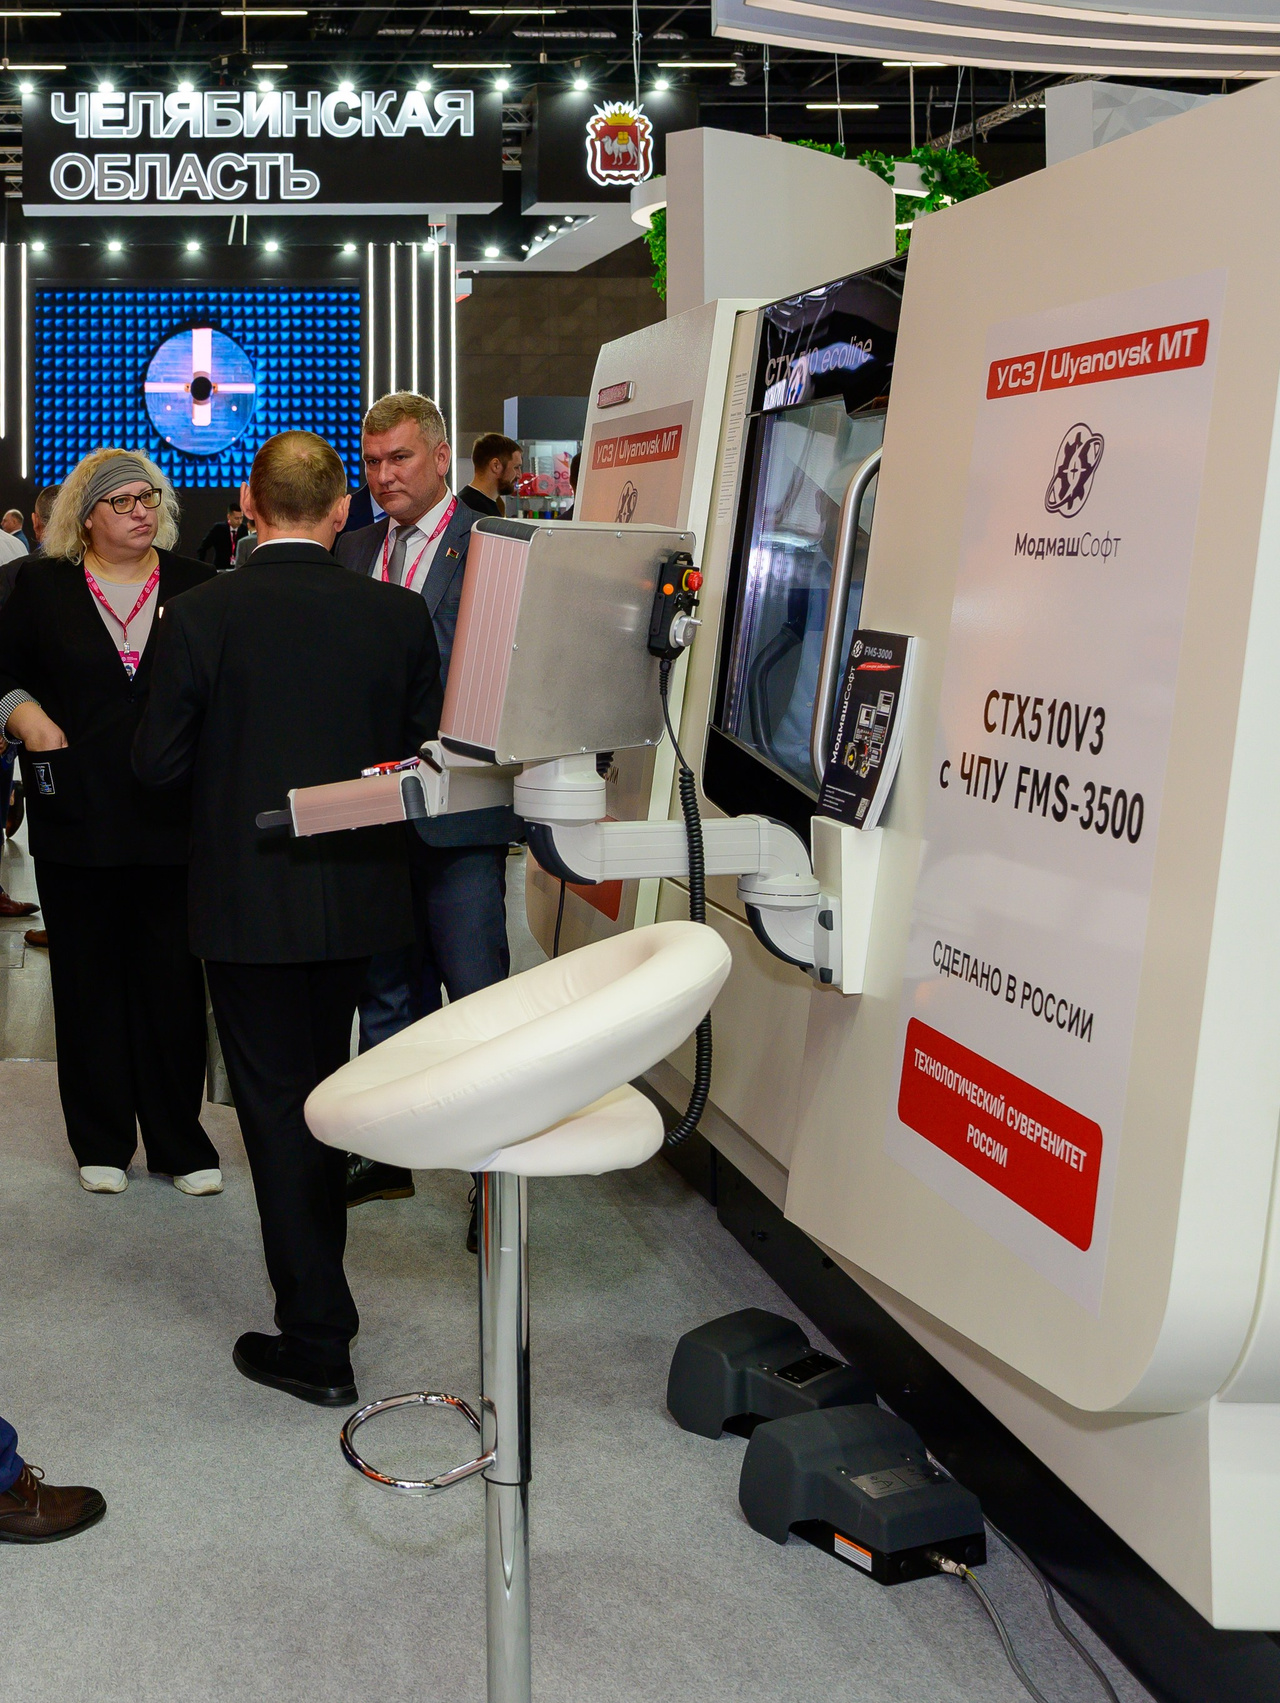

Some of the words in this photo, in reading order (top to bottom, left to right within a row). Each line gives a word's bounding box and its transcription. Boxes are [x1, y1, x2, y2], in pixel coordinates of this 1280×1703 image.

[50, 90, 475, 139] ЧЕЛЯБИНСКАЯ
[50, 153, 320, 200] ОБЛАСТЬ
[765, 353, 795, 386] CTX
[822, 336, 873, 373] ecoline
[1051, 338, 1153, 383] Ulyanovsk
[1158, 327, 1198, 362] MT
[619, 433, 660, 464] Ulyanovsk
[662, 430, 678, 453] MT
[1014, 530, 1121, 563] МодмашСофт
[864, 646, 893, 660] FMS-3000
[831, 666, 856, 764] МодмашСофт
[983, 690, 1106, 755] CTX510V3
[939, 760, 951, 788] с
[960, 752, 1008, 803] ЧПУ
[1014, 765, 1144, 844] FMS-3500
[933, 940, 1002, 996] СДЕЛАНО
[1005, 974, 1017, 1003] В
[1020, 981, 1094, 1043] РОССИИ
[914, 1048, 1005, 1122] ТЕХНОЛОГИЧЕСКИЙ
[1006, 1106, 1087, 1172] СУВЕРЕНИТЕТ
[967, 1123, 1008, 1168] РОССИИ
